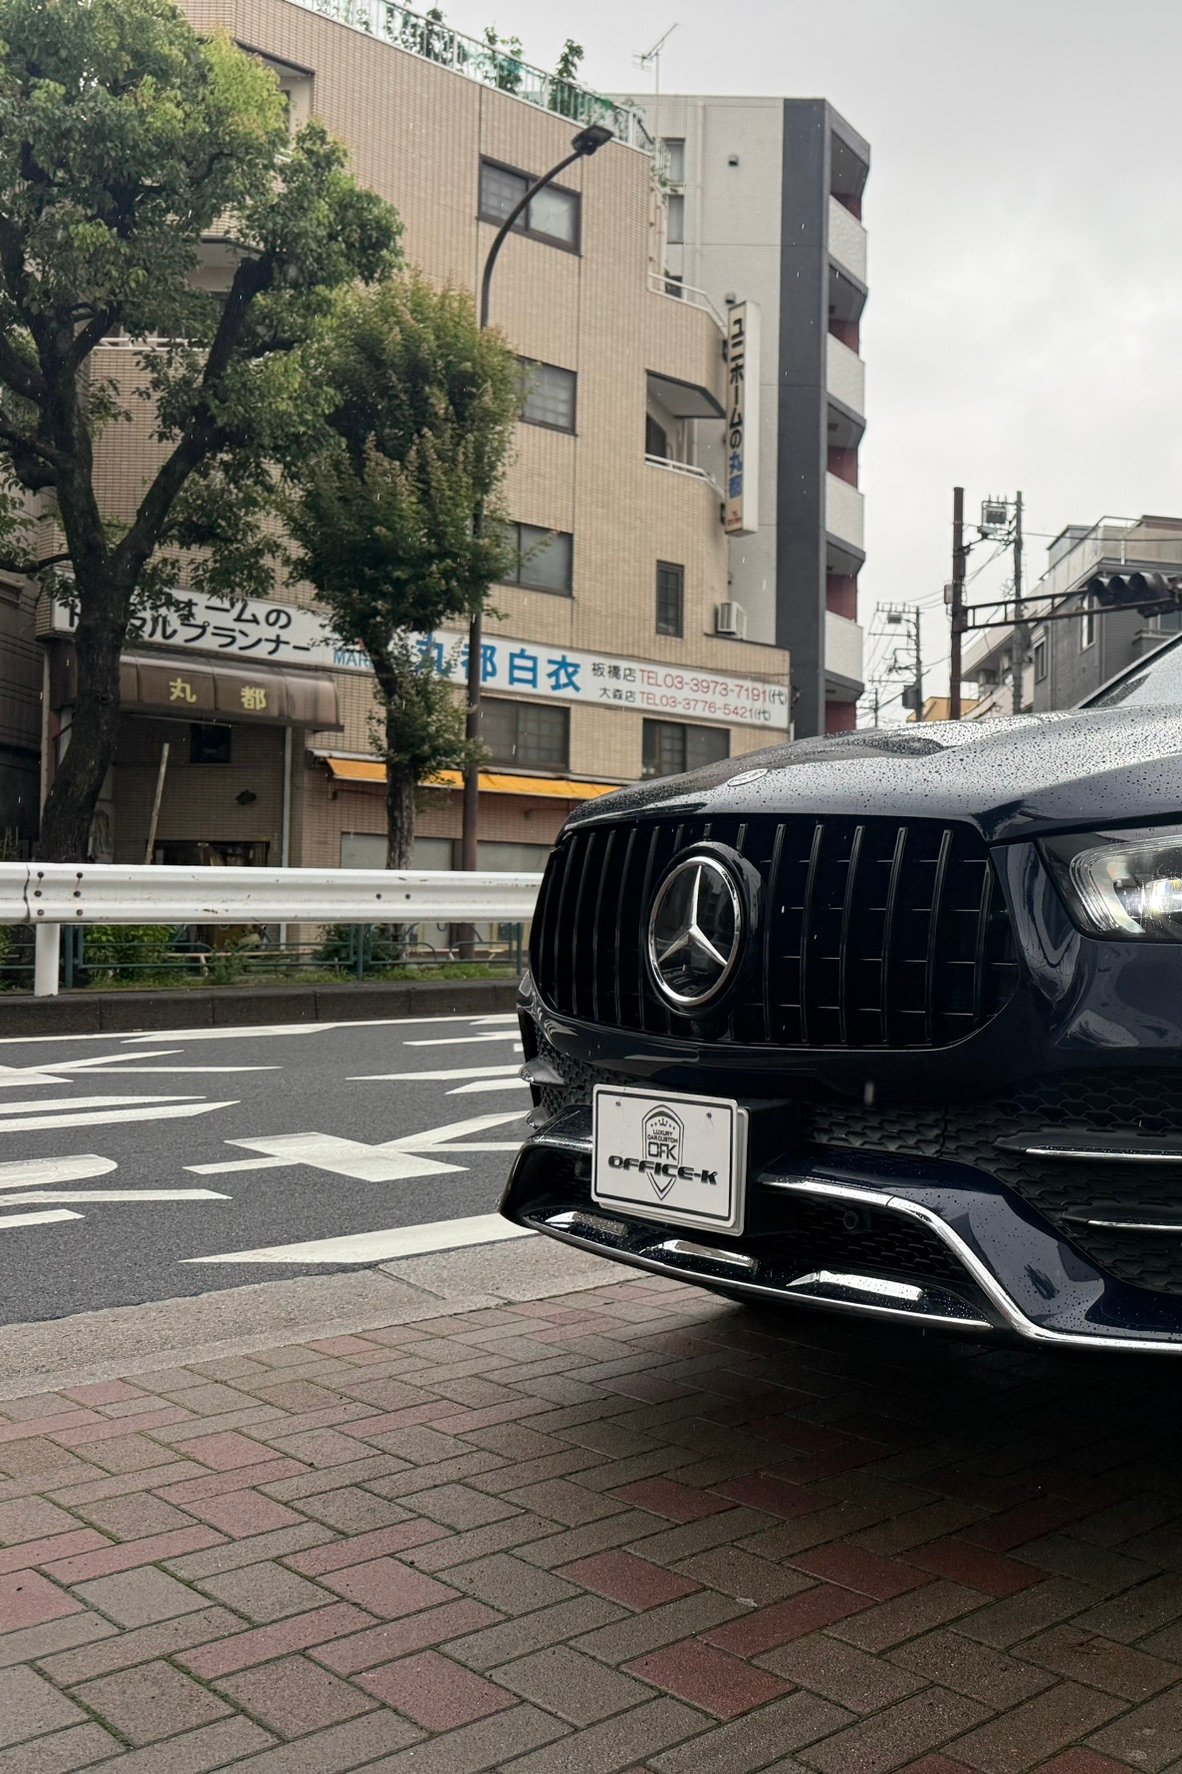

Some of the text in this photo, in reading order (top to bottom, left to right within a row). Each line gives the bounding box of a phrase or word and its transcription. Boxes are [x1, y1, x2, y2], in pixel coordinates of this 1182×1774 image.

[333, 649, 374, 669] MAR
[591, 662, 636, 683] 板橋店
[599, 687, 636, 703] 大森店
[608, 1155, 718, 1185] OFFICE-K
